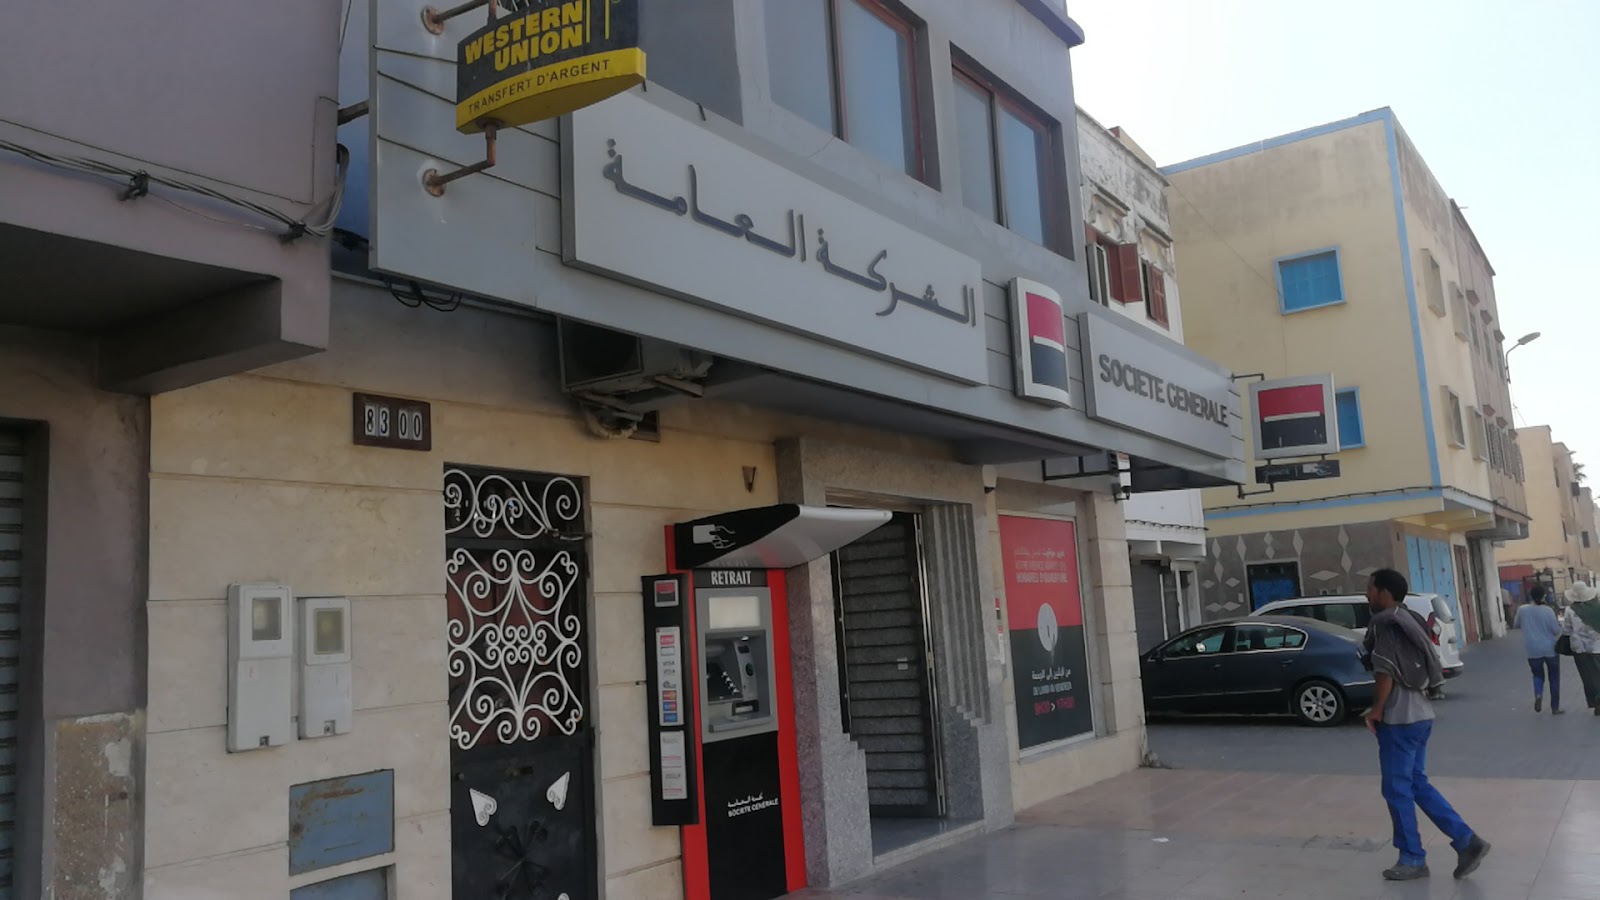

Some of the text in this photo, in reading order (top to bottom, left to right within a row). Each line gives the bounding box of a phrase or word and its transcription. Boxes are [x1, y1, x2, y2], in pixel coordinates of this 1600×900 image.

[465, 0, 583, 65] WESTERN
[494, 24, 583, 71] UNION
[468, 59, 611, 115] TRANSFERT D'ARGENT
[602, 138, 977, 328] الشركة العامة
[1099, 354, 1229, 428] SOCIETE GENERALE
[711, 570, 752, 585] RETRAIT
